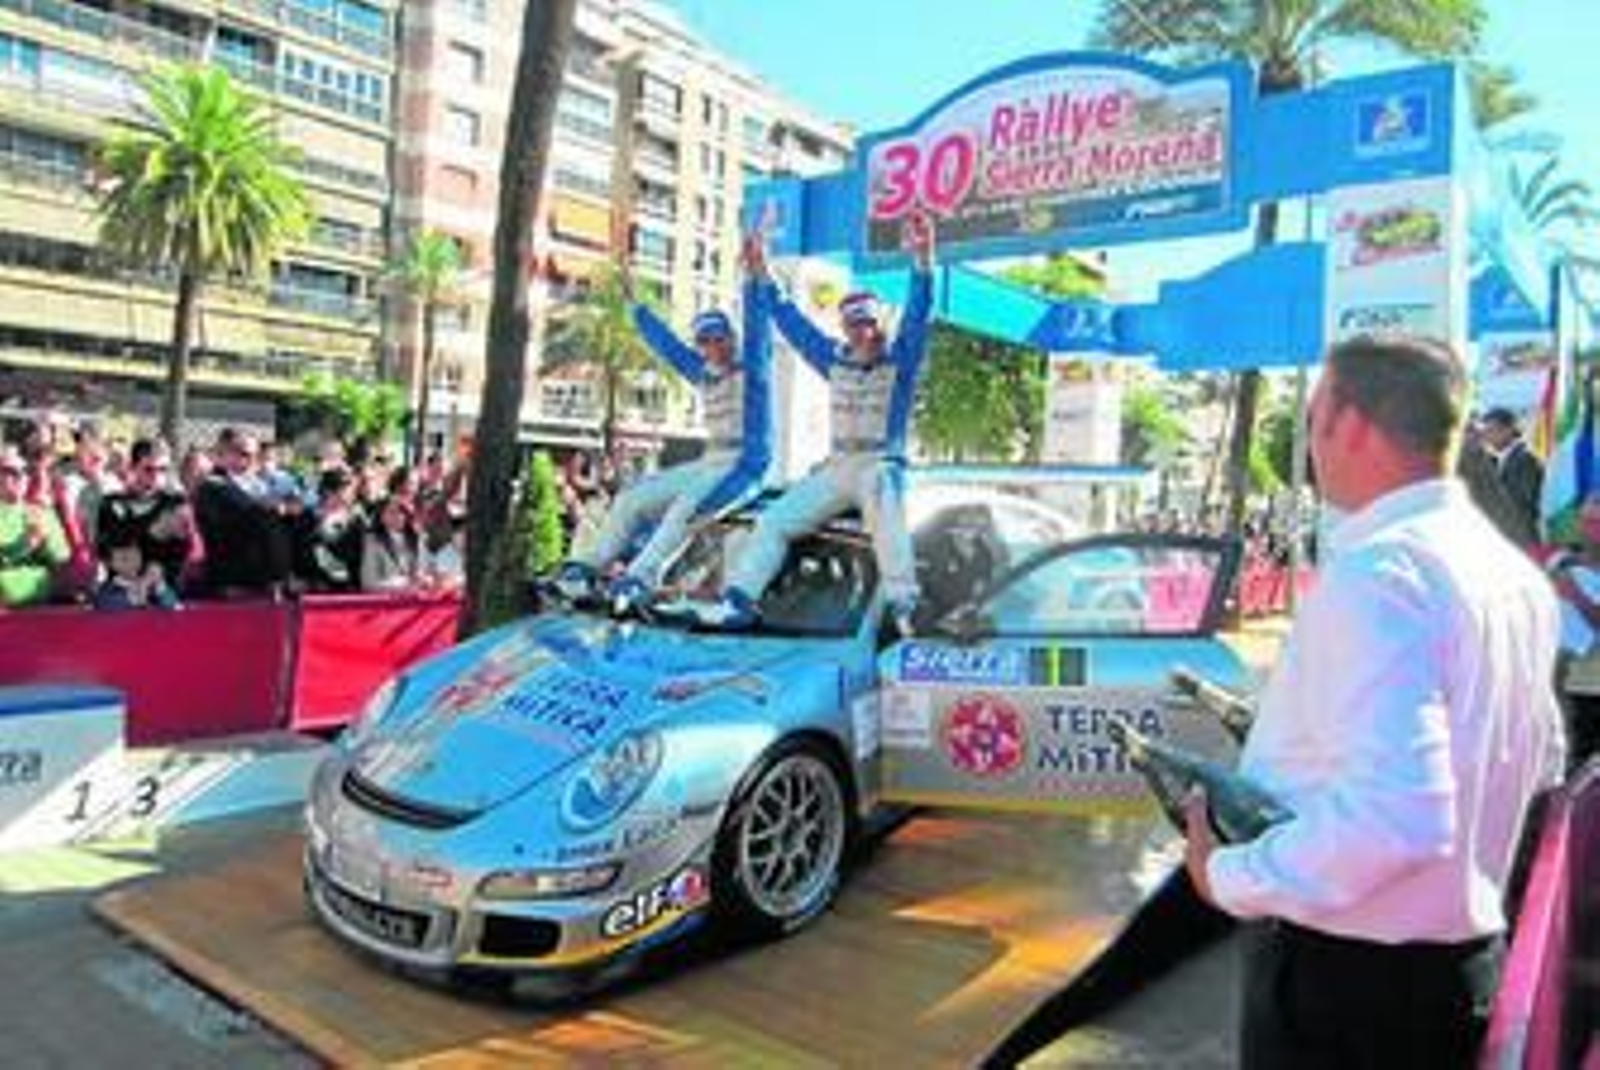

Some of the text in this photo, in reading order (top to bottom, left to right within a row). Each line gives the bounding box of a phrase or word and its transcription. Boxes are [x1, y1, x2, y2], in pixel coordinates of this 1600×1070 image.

[873, 91, 1122, 216] 30 Rallye
[984, 158, 1074, 197] Sierra
[1090, 131, 1220, 178] Morena
[64, 780, 91, 824] 1
[130, 776, 160, 818] 3
[603, 884, 672, 936] elf
